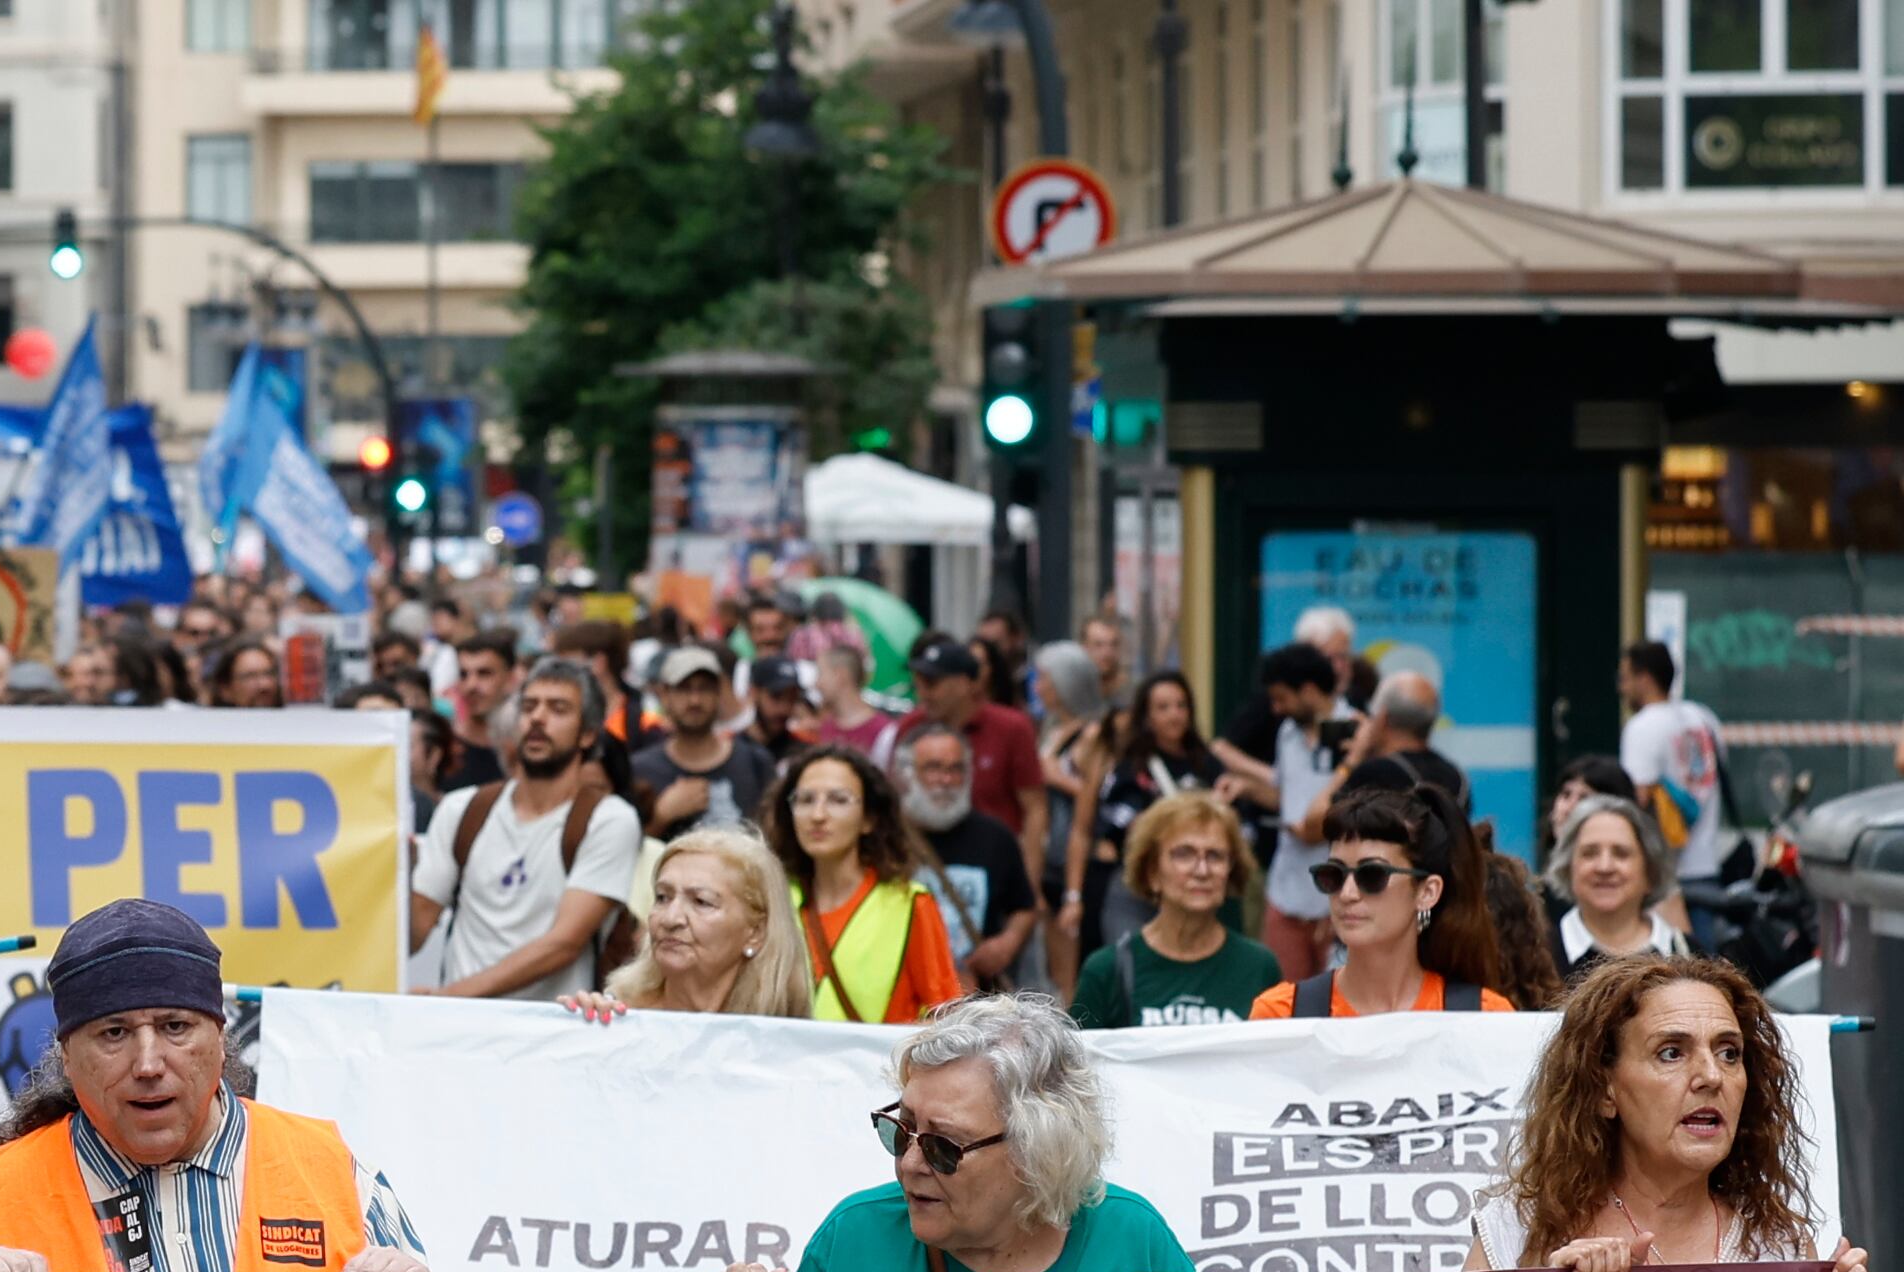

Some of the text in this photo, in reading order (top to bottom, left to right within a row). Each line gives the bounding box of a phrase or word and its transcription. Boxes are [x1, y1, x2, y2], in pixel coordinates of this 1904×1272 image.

[27, 767, 339, 929] PER
[1270, 1086, 1526, 1128] ABAIX
[1232, 1136, 1375, 1176] ELS
[120, 1196, 140, 1215] CAP
[126, 1212, 140, 1229] AL
[1200, 1187, 1302, 1239] DE
[261, 1225, 321, 1243] SINDICAT
[467, 1215, 792, 1270] ATURAR
